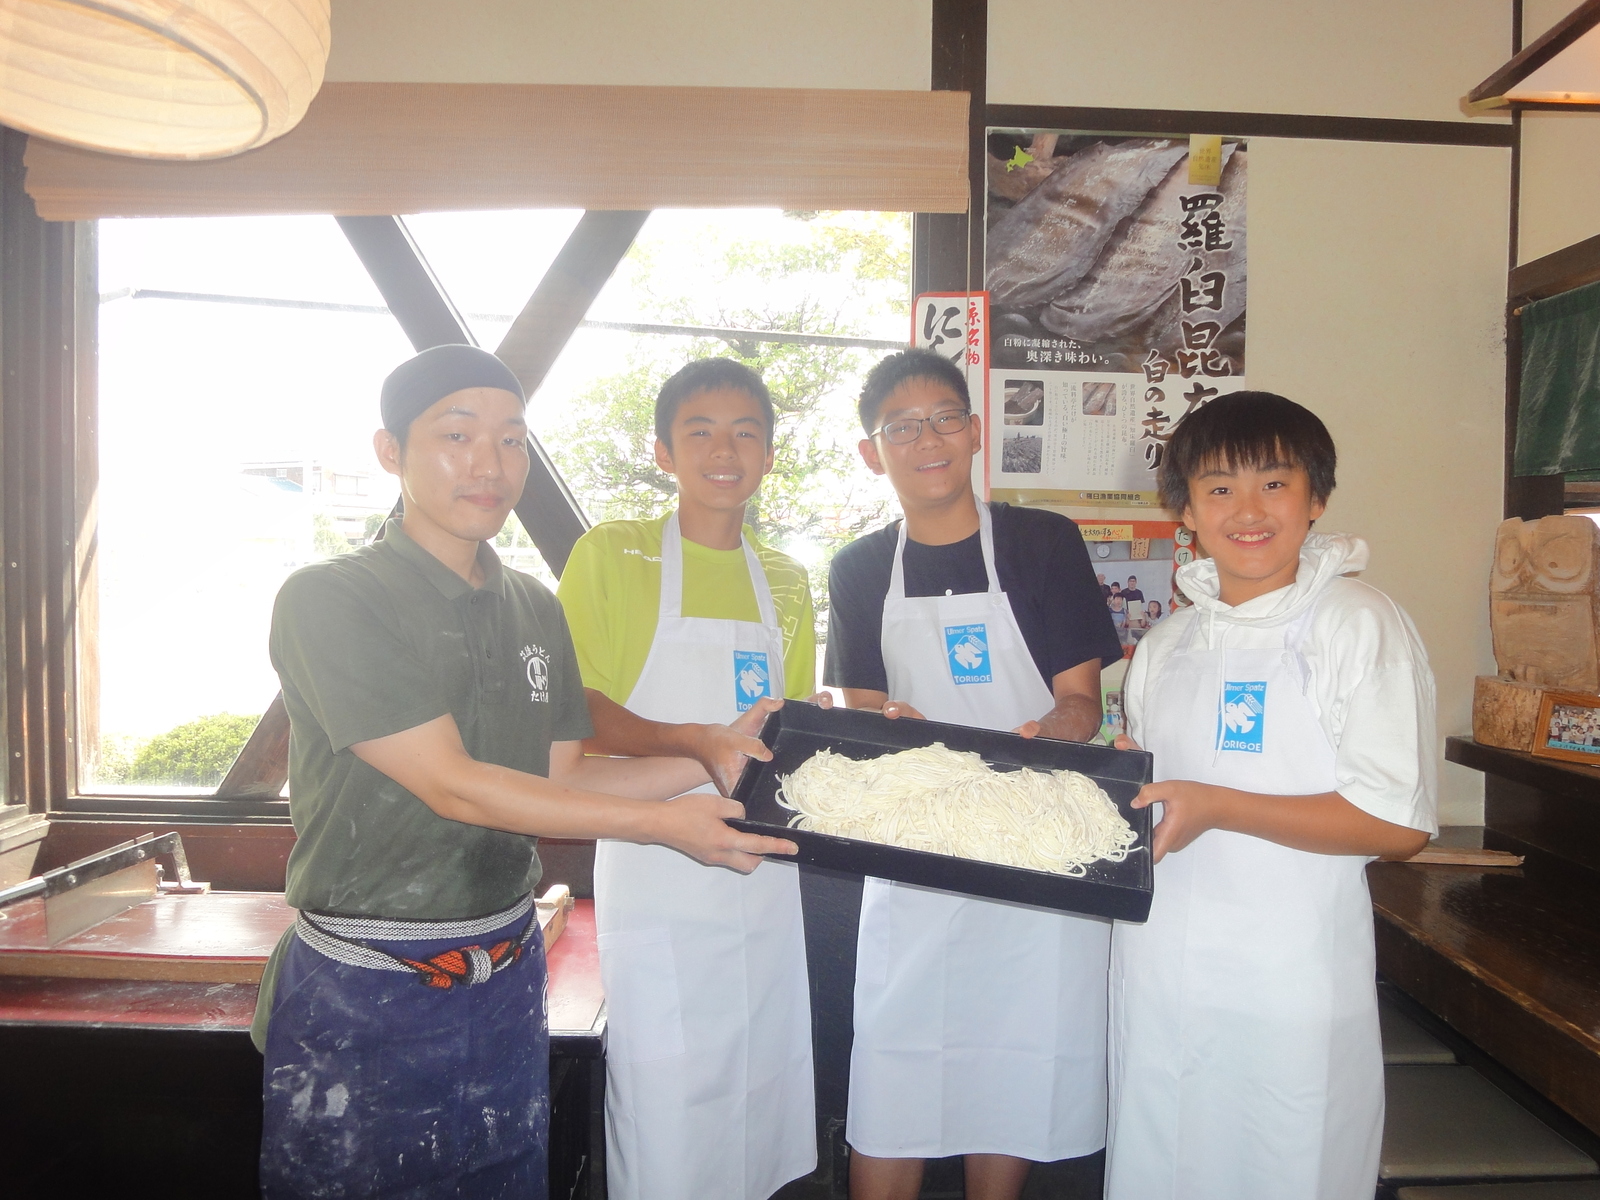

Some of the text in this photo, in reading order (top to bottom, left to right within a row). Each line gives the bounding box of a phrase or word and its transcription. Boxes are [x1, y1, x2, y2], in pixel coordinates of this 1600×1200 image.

[1025, 350, 1111, 365] 奥深き味わい。
[1139, 348, 1171, 471] 白の走り
[947, 626, 984, 636] Ulmer Spatz
[735, 652, 766, 661] Ulmer Spatz
[954, 674, 991, 683] TORIGOE
[1245, 684, 1265, 692] Spatz
[1223, 740, 1262, 751] ORIGOE
